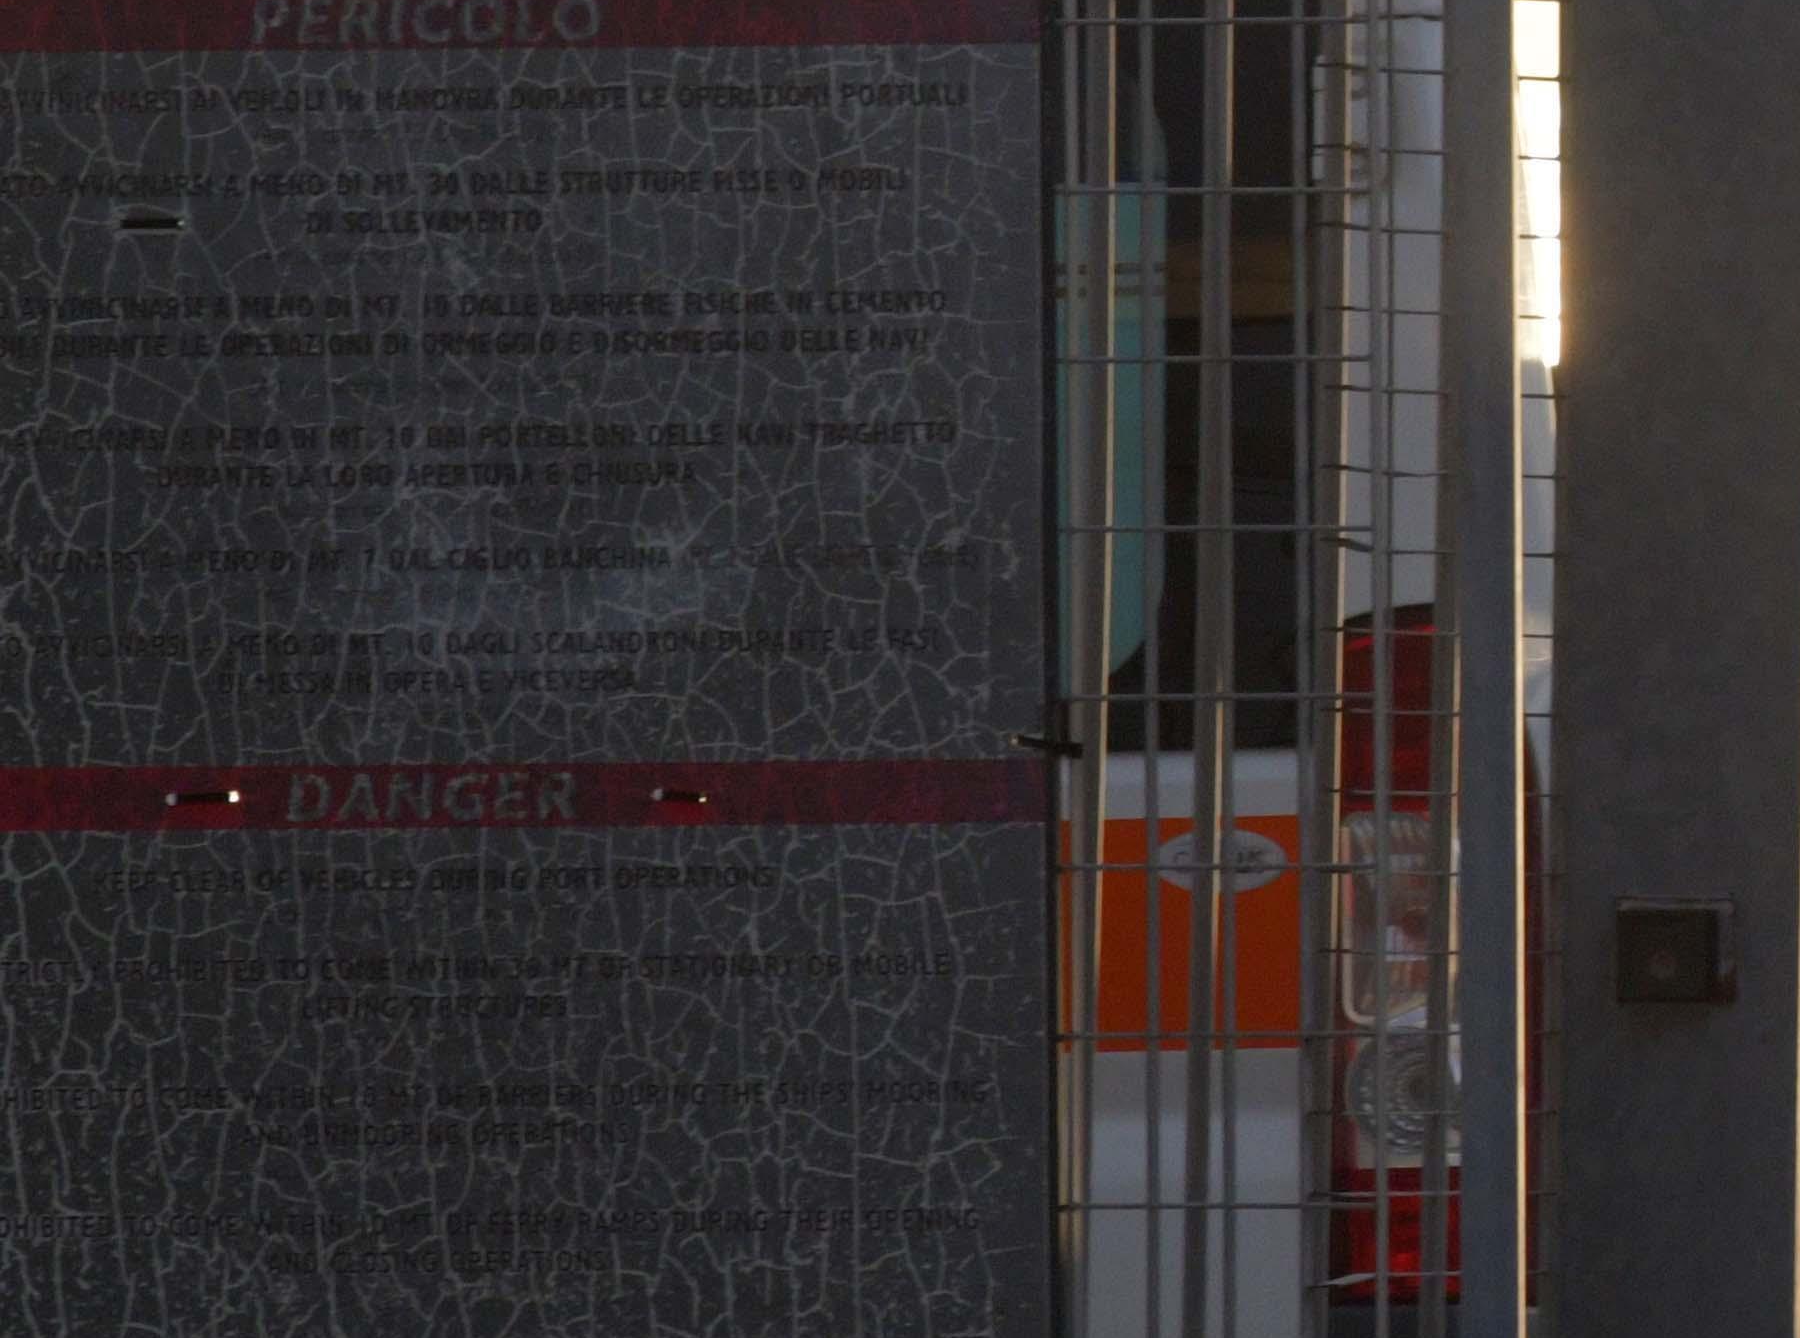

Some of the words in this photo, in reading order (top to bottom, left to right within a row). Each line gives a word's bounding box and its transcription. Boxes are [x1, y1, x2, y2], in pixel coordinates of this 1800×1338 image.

[512, 86, 627, 110] DURANTE
[636, 87, 669, 108] LE
[680, 86, 830, 109] OPERAZIONI
[842, 84, 969, 108] PORTUALI
[337, 173, 366, 196] DI
[471, 171, 549, 194] DALLE
[561, 170, 702, 194] STRUTTURE
[713, 169, 778, 192] FISSE
[817, 167, 908, 192] MOBILI
[305, 211, 334, 234] DI
[343, 209, 543, 234] SOLLEVAMENTO
[460, 293, 540, 317] DALLE
[550, 292, 673, 317] BARRIERE
[826, 290, 948, 314] CEMENTO
[180, 334, 213, 357] LE
[423, 332, 558, 356] ORMEGGIO
[568, 331, 585, 353] E
[594, 330, 770, 354] DISORMEGGIO
[782, 329, 860, 353] DELLE
[479, 424, 634, 449] PORTELLONI
[648, 423, 727, 448] DELLE
[803, 421, 959, 446] TRAGHETTO
[287, 466, 316, 488] LA
[405, 464, 532, 488] APERTURA
[545, 463, 561, 485] E
[573, 462, 697, 487] CHIUSURA
[388, 548, 437, 571] DAL
[448, 547, 530, 571] CIGLIO
[543, 547, 673, 571] BANCHINA
[446, 632, 521, 657] DAGLI
[530, 631, 708, 655] SCALANDRONI
[718, 629, 835, 654] DURANTE
[848, 629, 881, 652] LE
[888, 628, 943, 652] FASI
[385, 670, 468, 694] OPERA
[478, 669, 494, 692] E
[503, 667, 637, 693] VICEVERSA
[287, 771, 576, 822] DANGER
[170, 868, 247, 893] CLEAR
[257, 868, 291, 892] OF
[302, 867, 417, 892] VEHICLES
[430, 867, 528, 892] DURING
[539, 867, 604, 891] PORT
[616, 865, 775, 891] OPERATIONS
[113, 959, 264, 983] PROHIBITED
[276, 958, 310, 982] TO
[320, 957, 392, 982] COME
[642, 953, 794, 978] STATIONARY
[805, 952, 842, 977] OR
[852, 951, 953, 976] MOBILE
[301, 997, 398, 1021] LIFTING
[408, 995, 568, 1021] STRUCTURES
[110, 1087, 146, 1111] TO
[158, 1086, 229, 1111] COME
[607, 1081, 706, 1107] DURING
[716, 1081, 767, 1105] THE
[866, 1079, 989, 1104] MOORING
[471, 1121, 632, 1147] OPERATIONS
[122, 1215, 158, 1239] TO
[170, 1214, 240, 1238] COME
[577, 1209, 661, 1234] RAMPS
[672, 1208, 768, 1233] DURING
[780, 1207, 854, 1232] THEIR
[863, 1206, 981, 1232] OPENING
[331, 1251, 441, 1275] CLOSING
[451, 1248, 611, 1275] OPERATIONS
